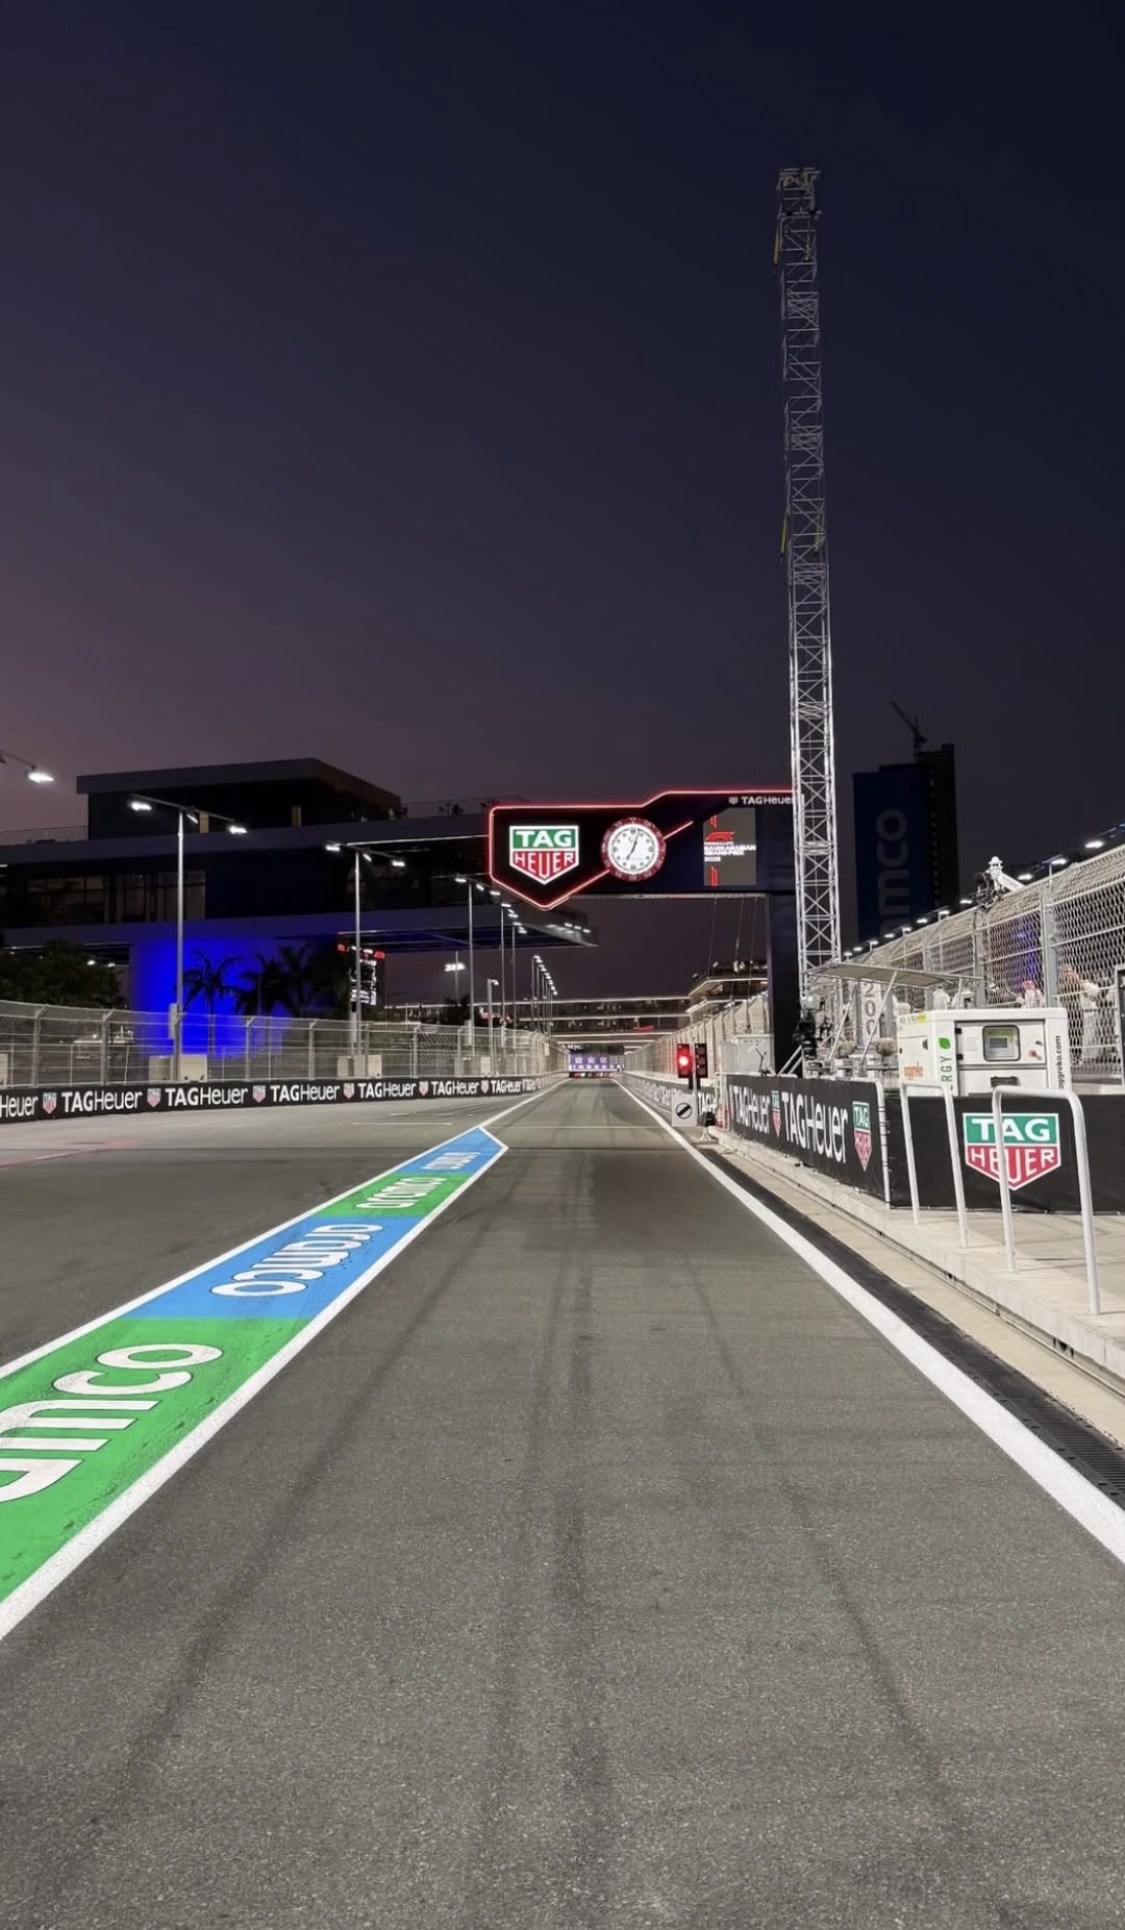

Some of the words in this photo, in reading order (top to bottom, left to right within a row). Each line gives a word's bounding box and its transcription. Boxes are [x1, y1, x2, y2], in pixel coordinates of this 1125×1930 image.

[515, 829, 572, 848] TAG
[514, 851, 575, 880] HEUER
[940, 1056, 953, 1087] RGY
[781, 1091, 848, 1164] TAGHeuer
[971, 1118, 1051, 1142] TAG
[971, 1148, 1055, 1183] HEUER
[209, 1223, 384, 1297] aramco
